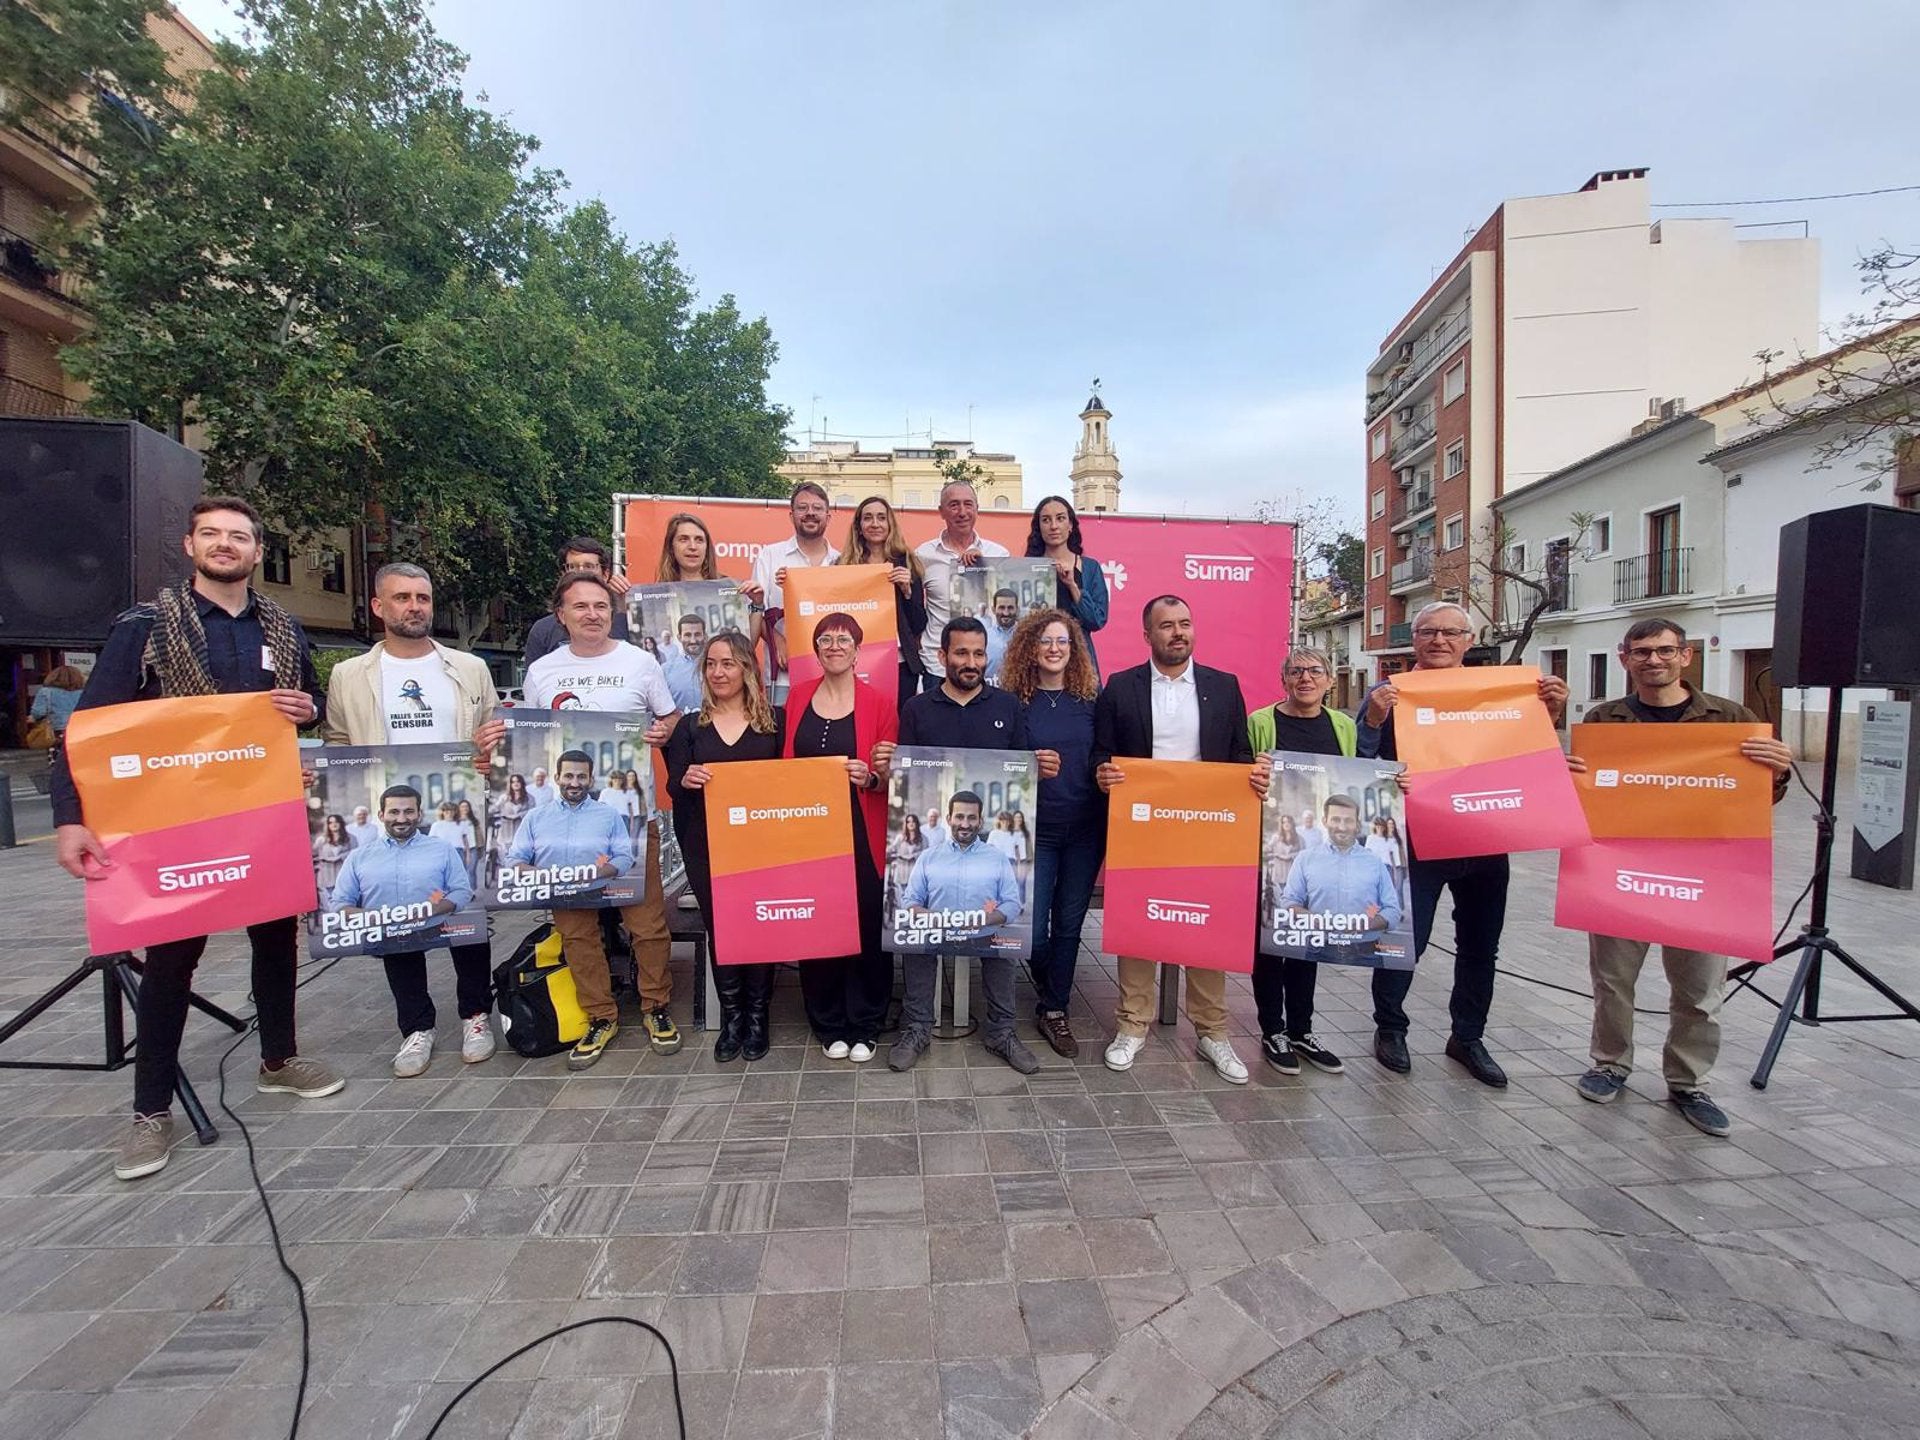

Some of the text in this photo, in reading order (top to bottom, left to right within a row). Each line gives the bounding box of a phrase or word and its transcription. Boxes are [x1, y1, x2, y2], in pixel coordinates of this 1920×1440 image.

[1184, 559, 1255, 582] Sumar
[816, 600, 879, 613] compromís
[557, 675, 624, 687] YES WE BIKE!
[391, 719, 434, 729] CENSURA
[516, 719, 561, 729] compromís
[1439, 707, 1522, 724] compromís
[615, 724, 640, 732] Sumar
[147, 743, 267, 769] compromís
[330, 756, 382, 766] compromís
[913, 758, 954, 768] compromís
[1622, 773, 1737, 789] compromís
[750, 803, 828, 822] compromís
[1452, 795, 1524, 813] Sumar
[1153, 808, 1236, 823] compromís
[158, 864, 251, 892] Sumar
[497, 863, 597, 888] Plantem
[496, 885, 550, 904] cara
[1616, 874, 1703, 901] Sumar
[322, 901, 433, 934] Plantem
[755, 905, 815, 921] Sumar
[894, 907, 986, 930] Plantem
[1146, 903, 1210, 925] Sumar
[1273, 907, 1369, 931] Plantem
[322, 926, 383, 949] cara
[893, 929, 942, 945] cara
[1272, 929, 1325, 947] cara
